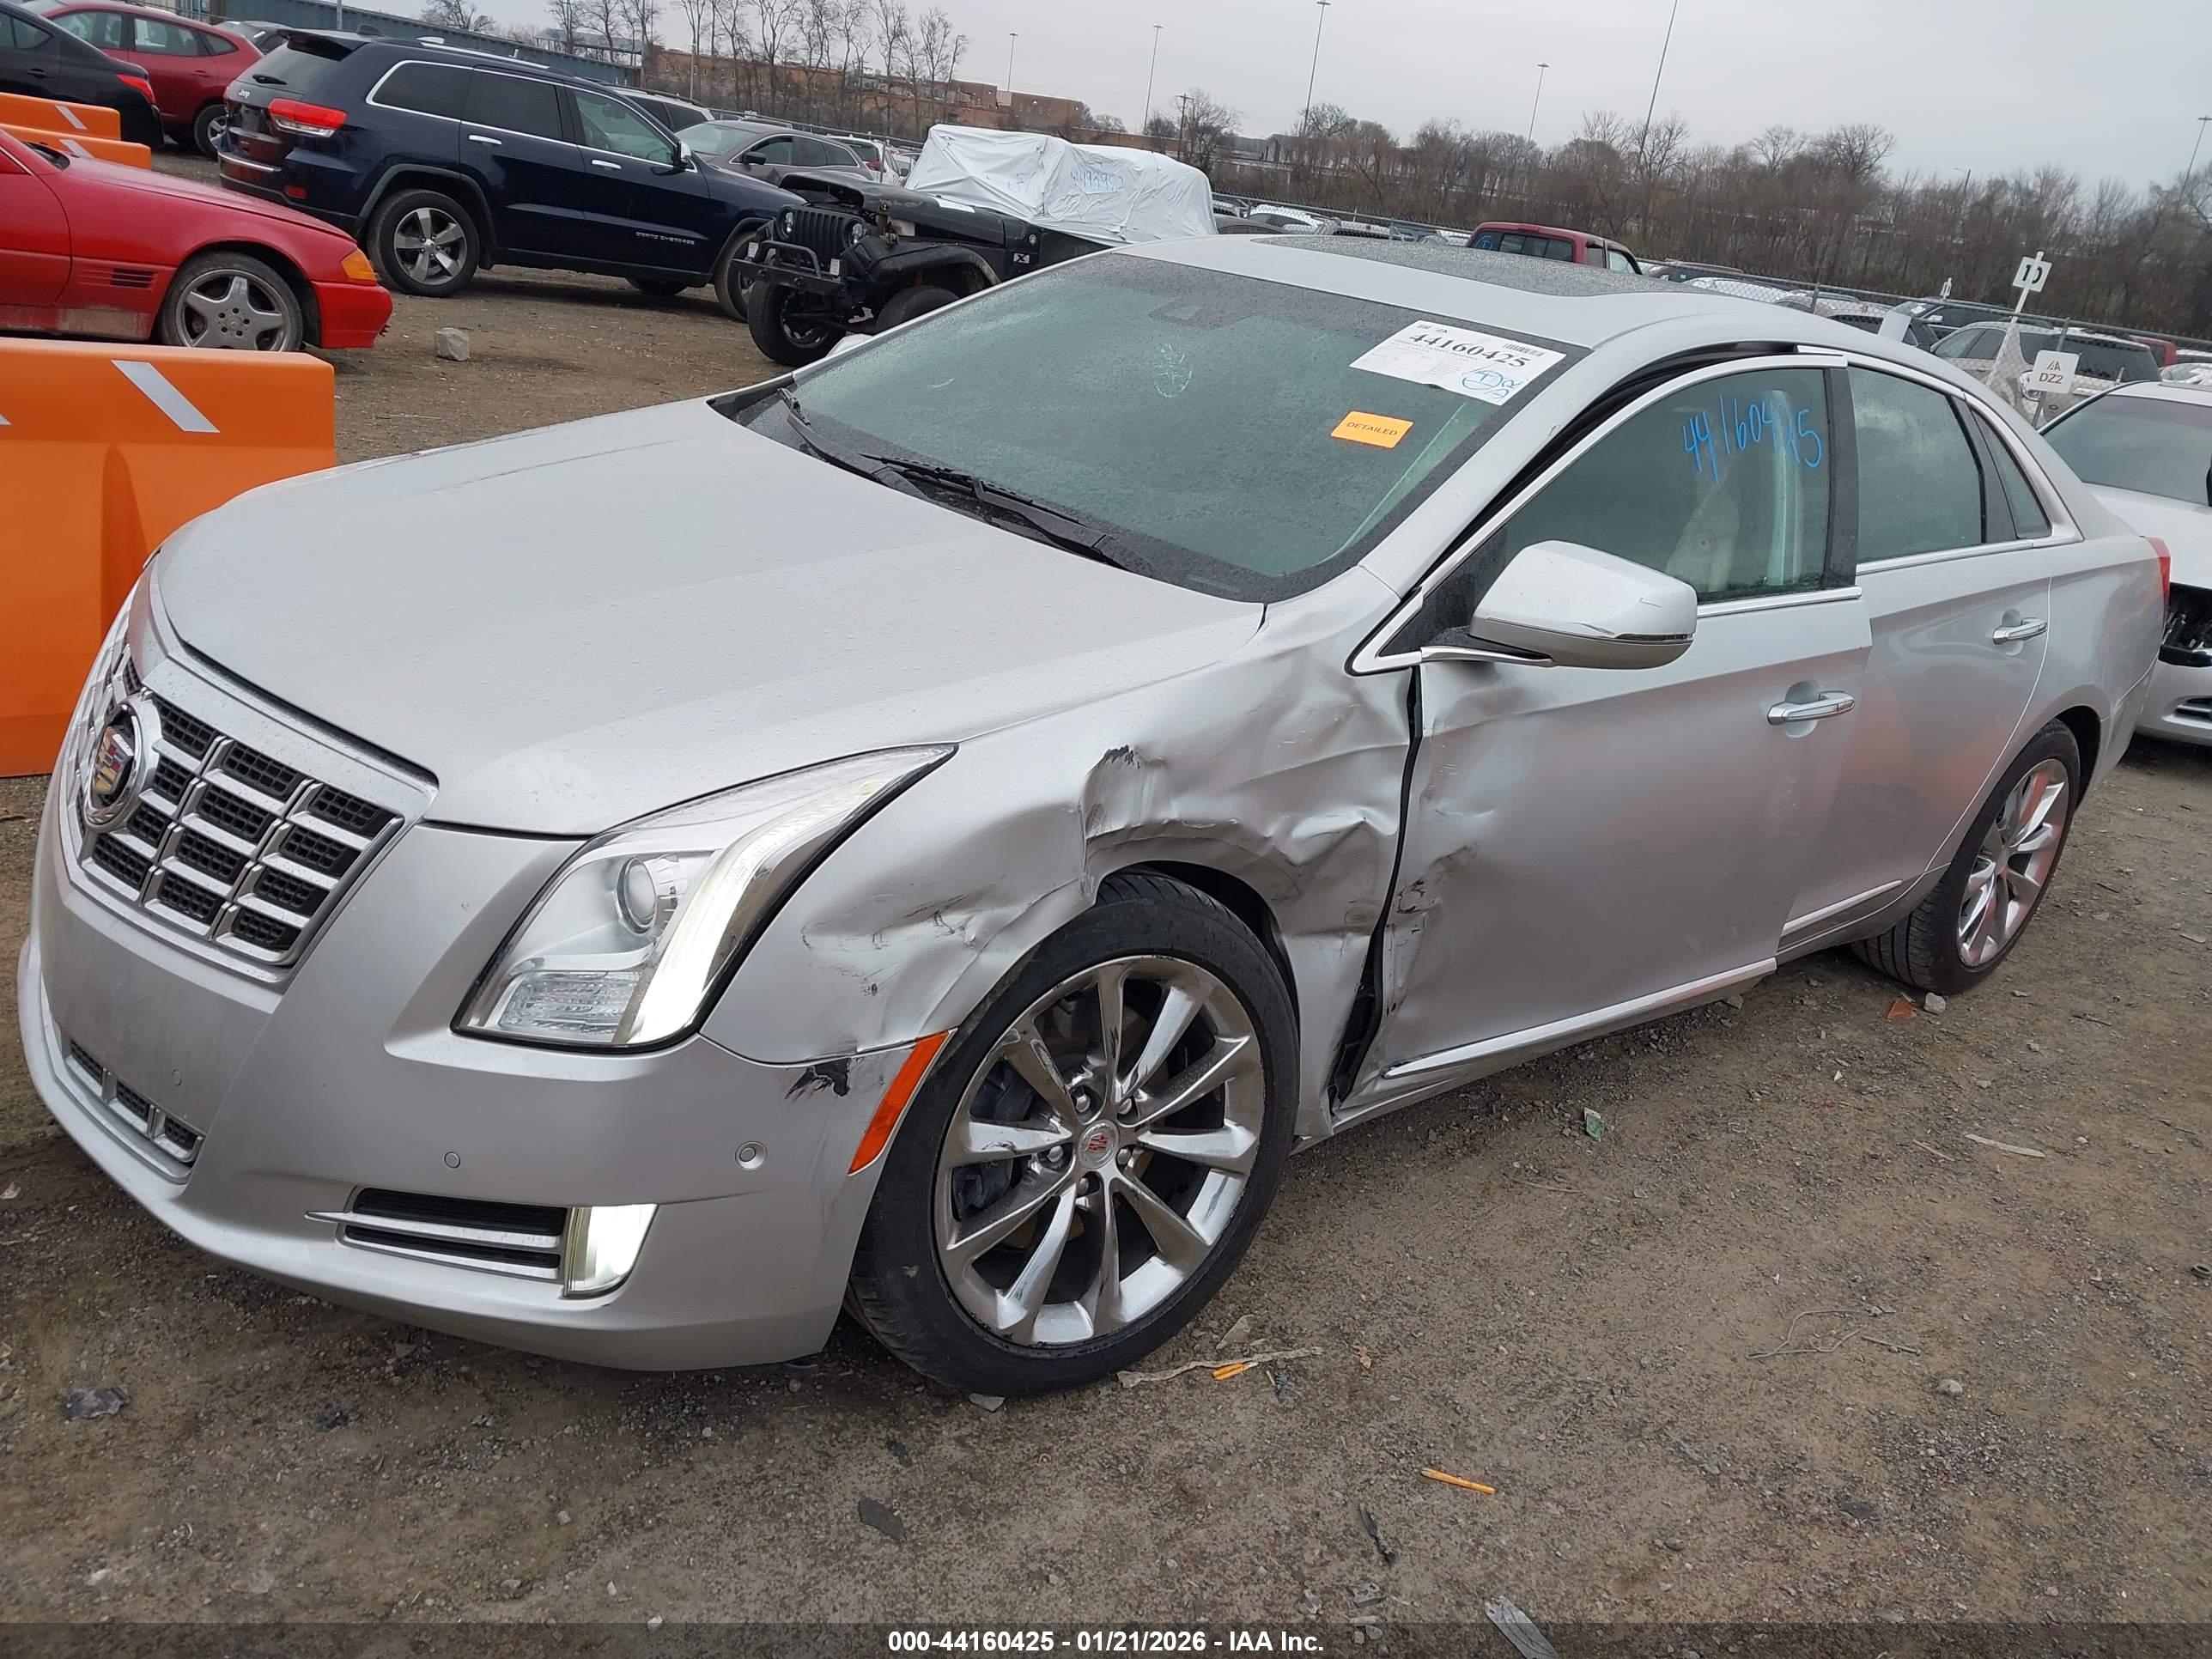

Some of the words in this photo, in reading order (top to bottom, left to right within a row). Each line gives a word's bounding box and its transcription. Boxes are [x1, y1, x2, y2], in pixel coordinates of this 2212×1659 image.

[1409, 332, 1531, 368] 44160425
[2039, 372, 2064, 385] DZ2
[1346, 421, 1399, 436] DETAILED
